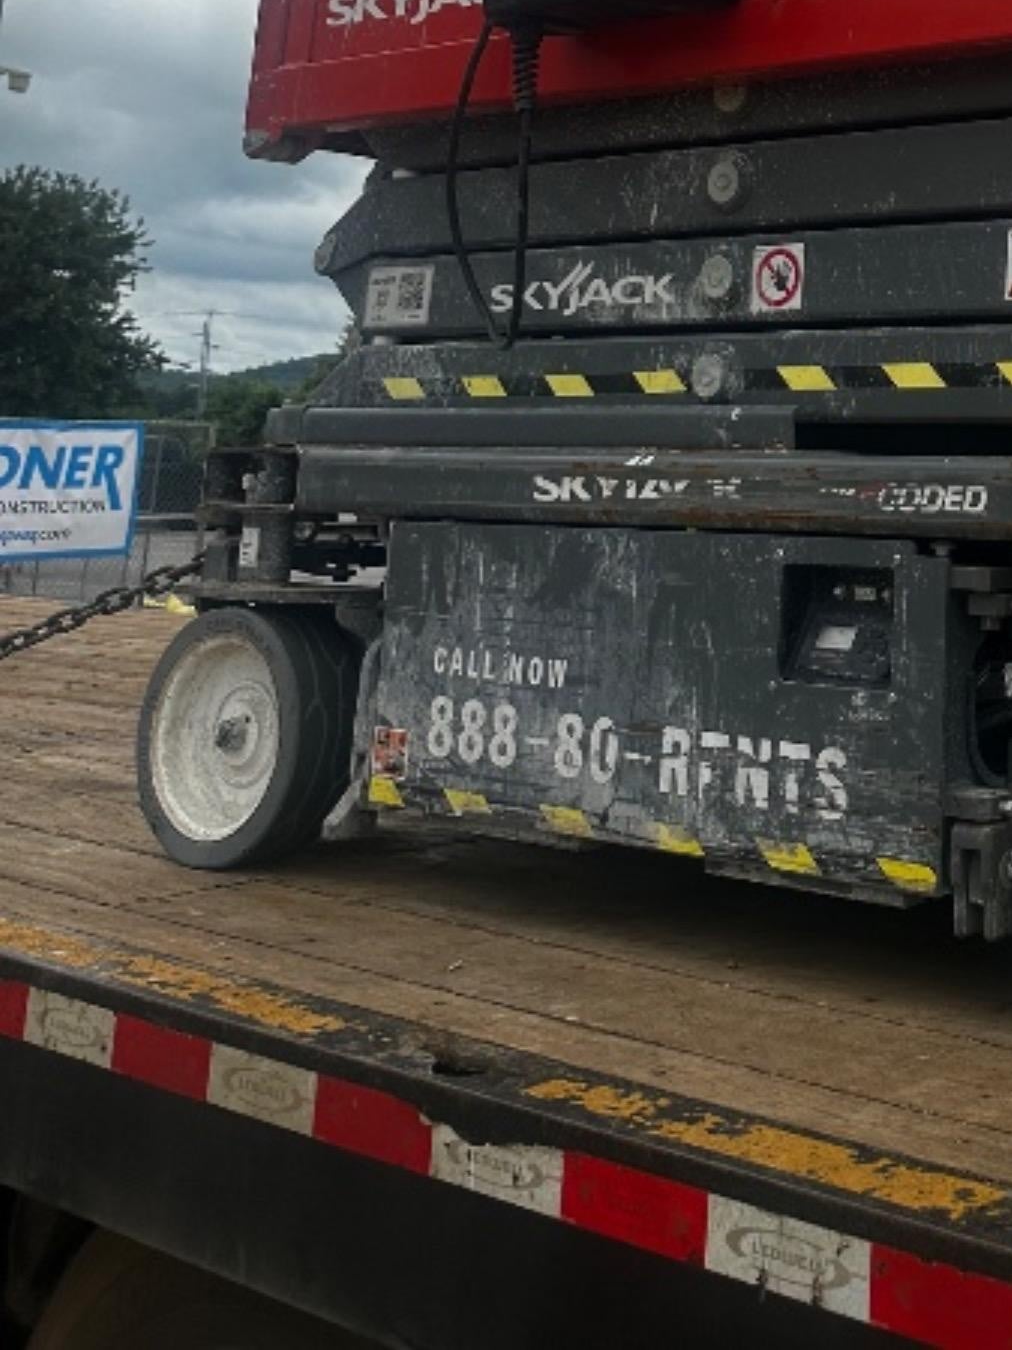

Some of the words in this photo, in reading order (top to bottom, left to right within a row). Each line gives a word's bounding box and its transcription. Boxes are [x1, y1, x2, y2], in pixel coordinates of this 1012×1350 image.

[490, 260, 676, 316] SKYJACK
[433, 647, 495, 679] CALL
[509, 653, 568, 688] NOW
